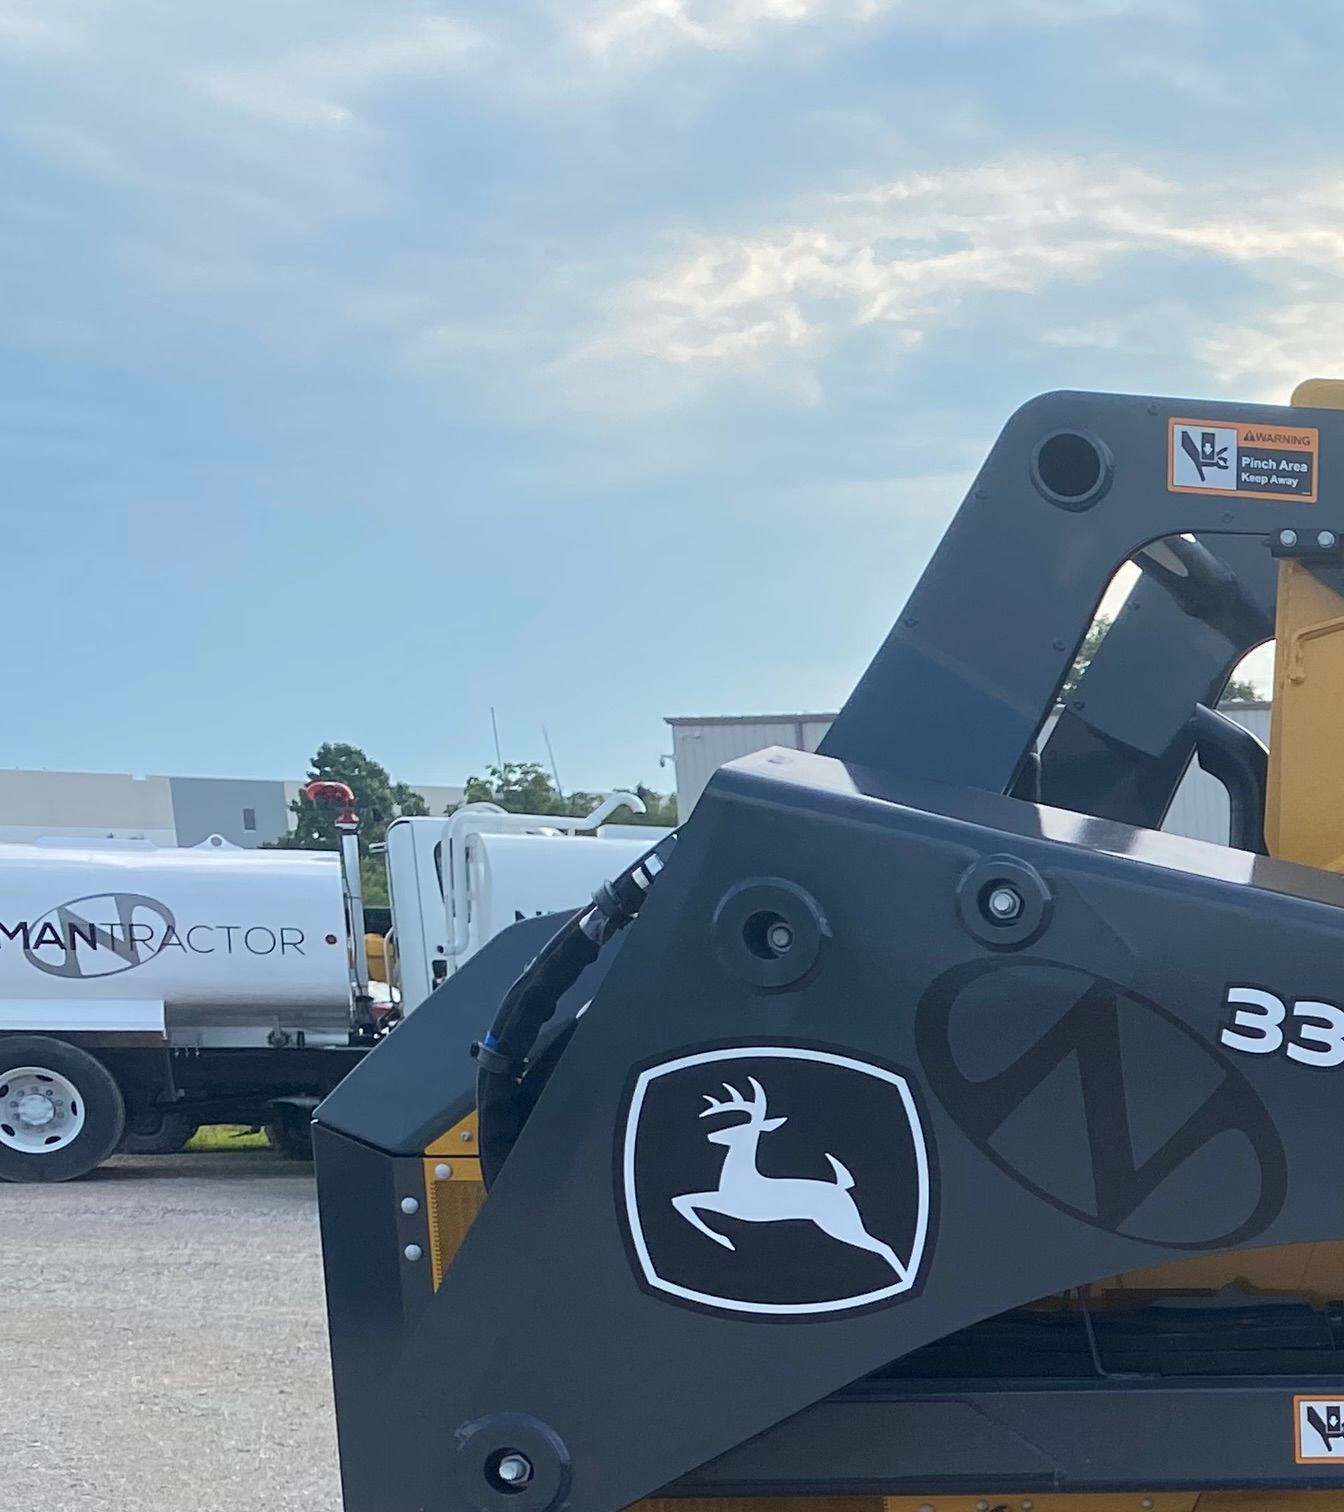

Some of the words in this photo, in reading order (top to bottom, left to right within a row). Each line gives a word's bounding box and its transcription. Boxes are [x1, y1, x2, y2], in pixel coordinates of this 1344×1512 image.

[1255, 432, 1311, 446] WARNING
[1241, 456, 1277, 470] Pinch
[1279, 460, 1308, 473] Area
[1241, 472, 1268, 485] Keep
[1270, 474, 1299, 488] Away
